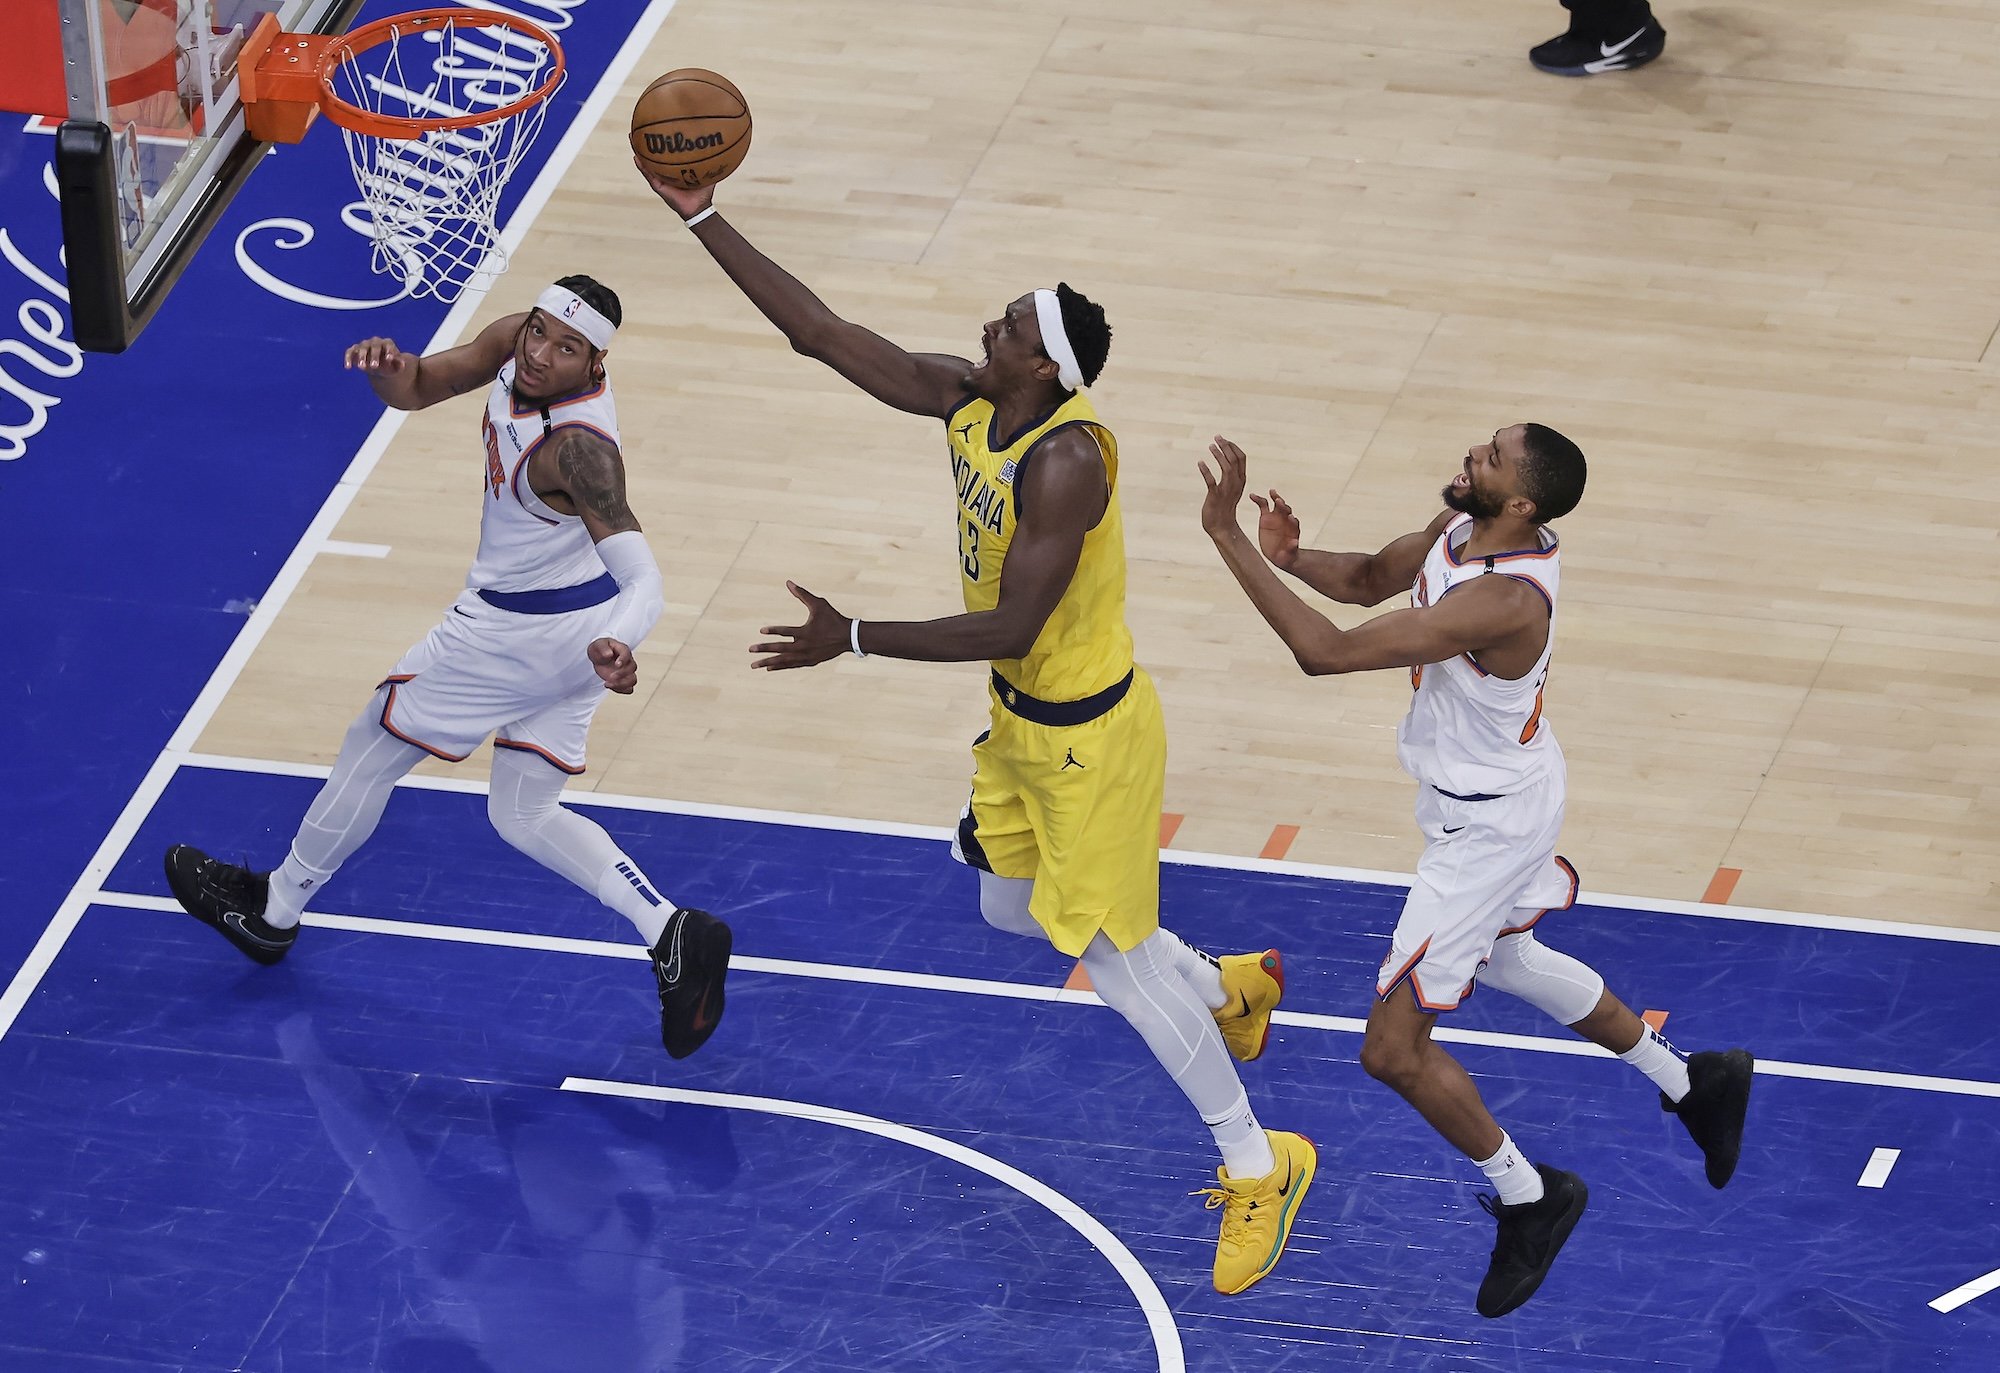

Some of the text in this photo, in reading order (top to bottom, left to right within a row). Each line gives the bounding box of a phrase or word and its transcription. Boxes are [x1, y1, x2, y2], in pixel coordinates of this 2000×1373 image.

[234, 0, 588, 310] Courtsid
[644, 131, 724, 154] Wilson
[950, 443, 1005, 536] NDIANA
